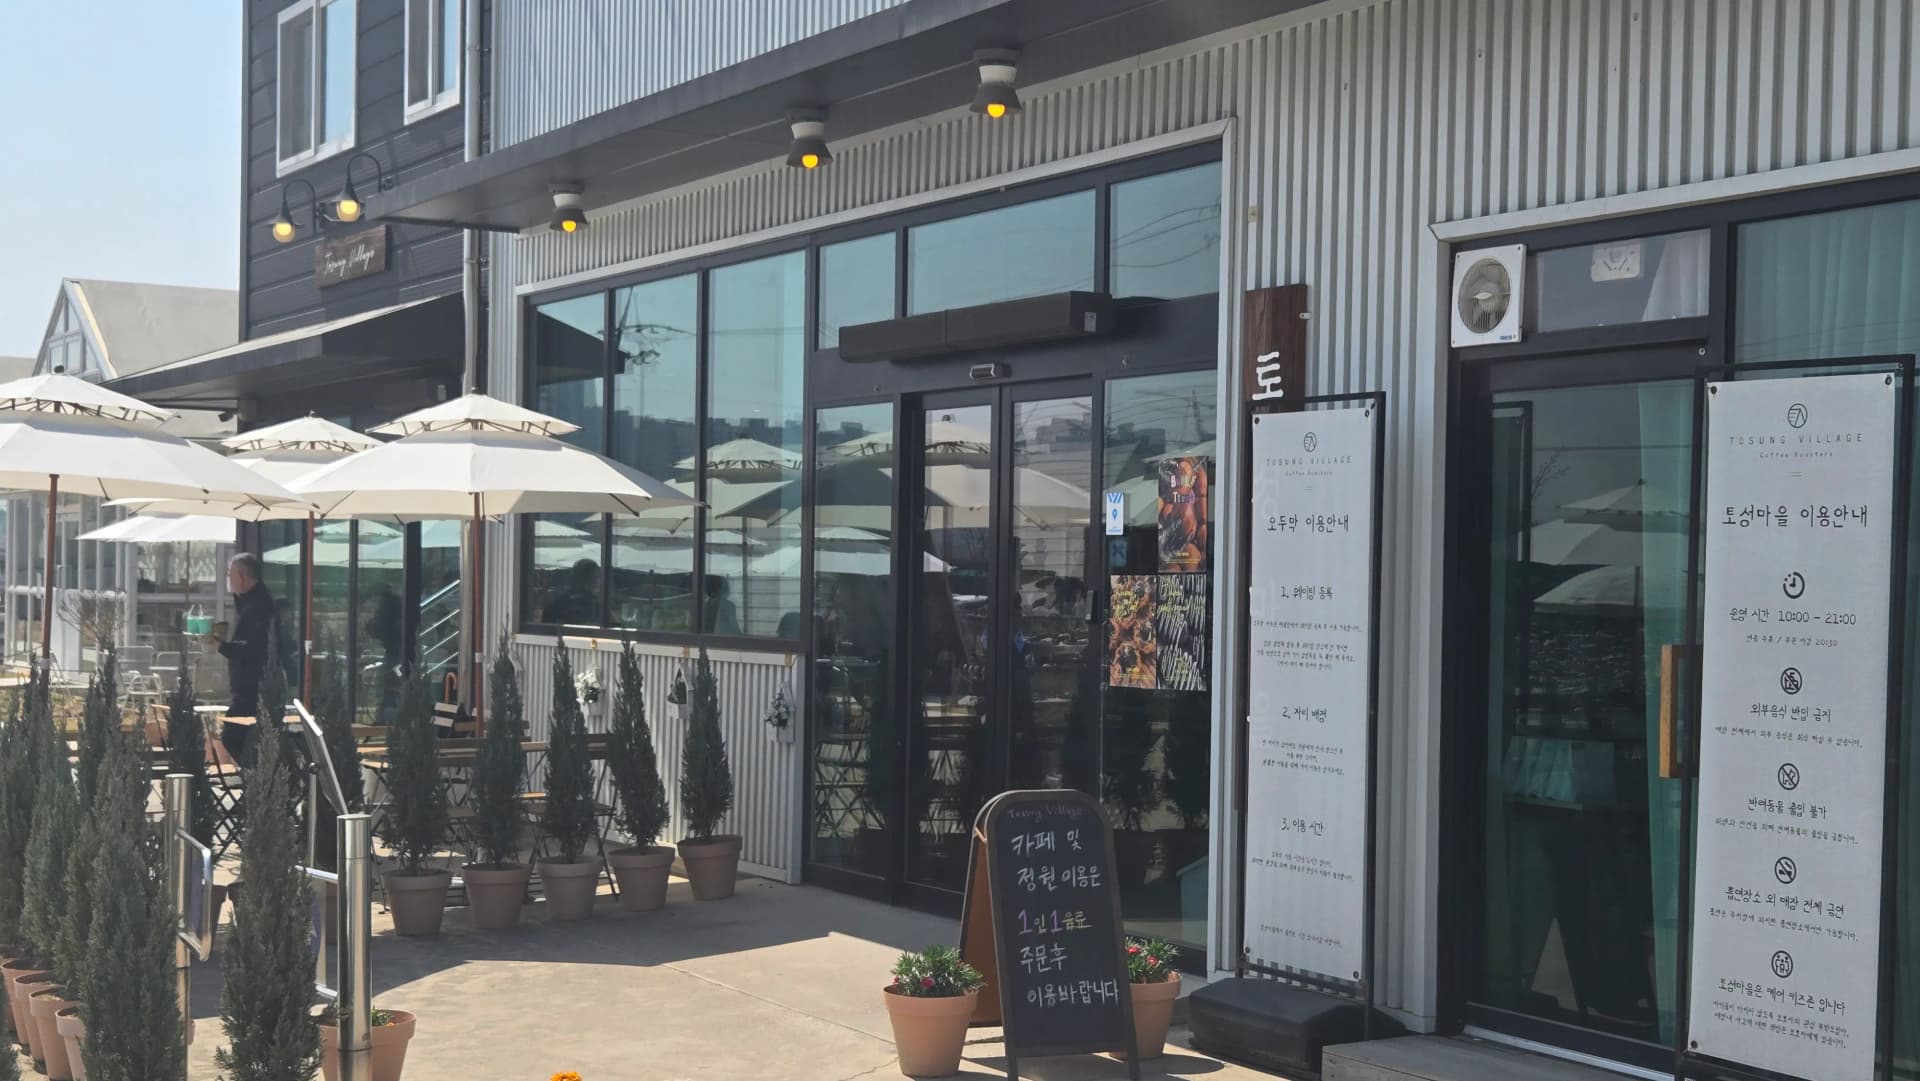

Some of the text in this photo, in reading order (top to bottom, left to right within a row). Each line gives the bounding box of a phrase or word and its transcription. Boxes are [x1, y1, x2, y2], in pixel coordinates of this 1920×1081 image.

[349, 242, 375, 271] Village
[1252, 351, 1284, 401] 토
[1729, 433, 1863, 446] TOSUNG VILLAGE
[1311, 455, 1352, 465] VILLAGE
[1759, 451, 1789, 459] Coffee
[1267, 514, 1349, 533] 오두막 이용안내
[1722, 504, 1868, 528] 토성마을 이용안내
[1281, 585, 1333, 601] 1. 웨이팅 등록
[1730, 608, 1748, 622] 운영
[1751, 608, 1770, 623] 시간
[1778, 610, 1810, 623] 10:00
[1825, 613, 1857, 625] 21:00
[1815, 639, 1838, 648] 20:30
[1282, 705, 1327, 723] 2. 자리 배정
[1750, 703, 1831, 723] 외부음식 반입 금지
[1747, 796, 1828, 820] 반려동물 출입 불가
[1281, 817, 1324, 837] 3. 이용 시간
[1010, 828, 1082, 858] 카페 및
[1017, 865, 1101, 892] 정원 이용은
[1725, 885, 1844, 919] 흡연장소 외 매장 전체 금연
[1020, 943, 1069, 974] 주문후
[1027, 978, 1119, 1009] 이용바랍니다
[1718, 978, 1846, 1016] 토성마을은 케어 키즈존 입니다
